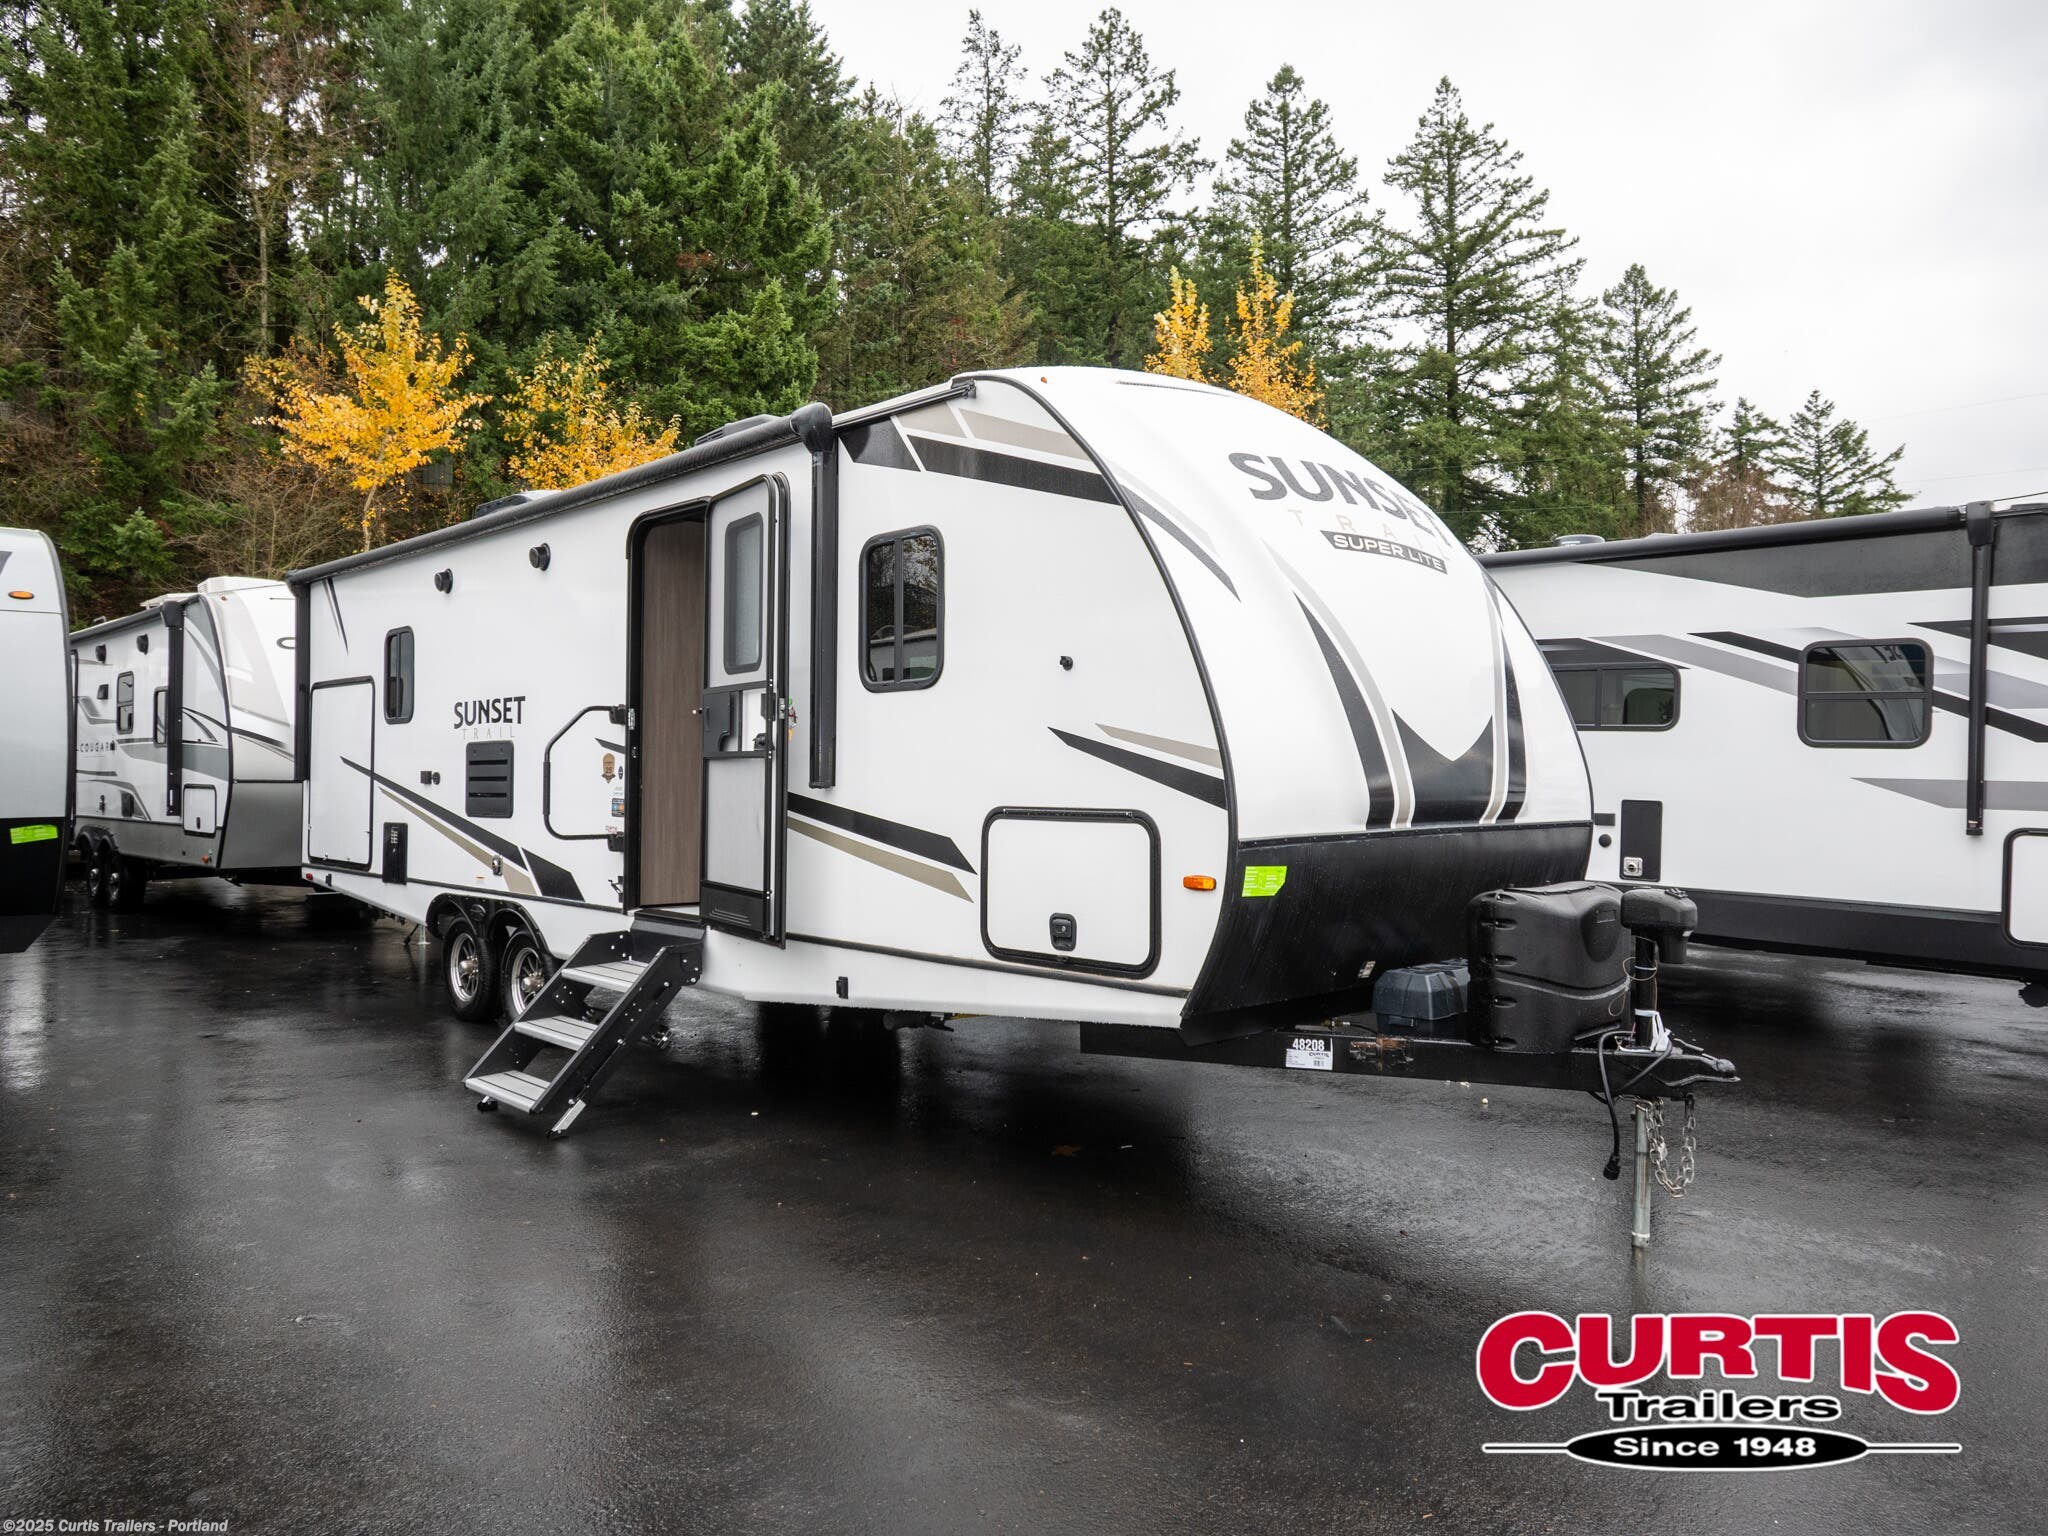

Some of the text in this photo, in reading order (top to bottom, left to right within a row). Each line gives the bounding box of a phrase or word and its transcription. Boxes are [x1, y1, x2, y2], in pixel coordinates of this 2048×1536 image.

[1229, 452, 1452, 548] SUNSET
[1333, 534, 1444, 571] SUPER LITE
[454, 696, 526, 729] SUNSET
[462, 726, 515, 740] TRAIL
[1292, 1038, 1325, 1051] 48208
